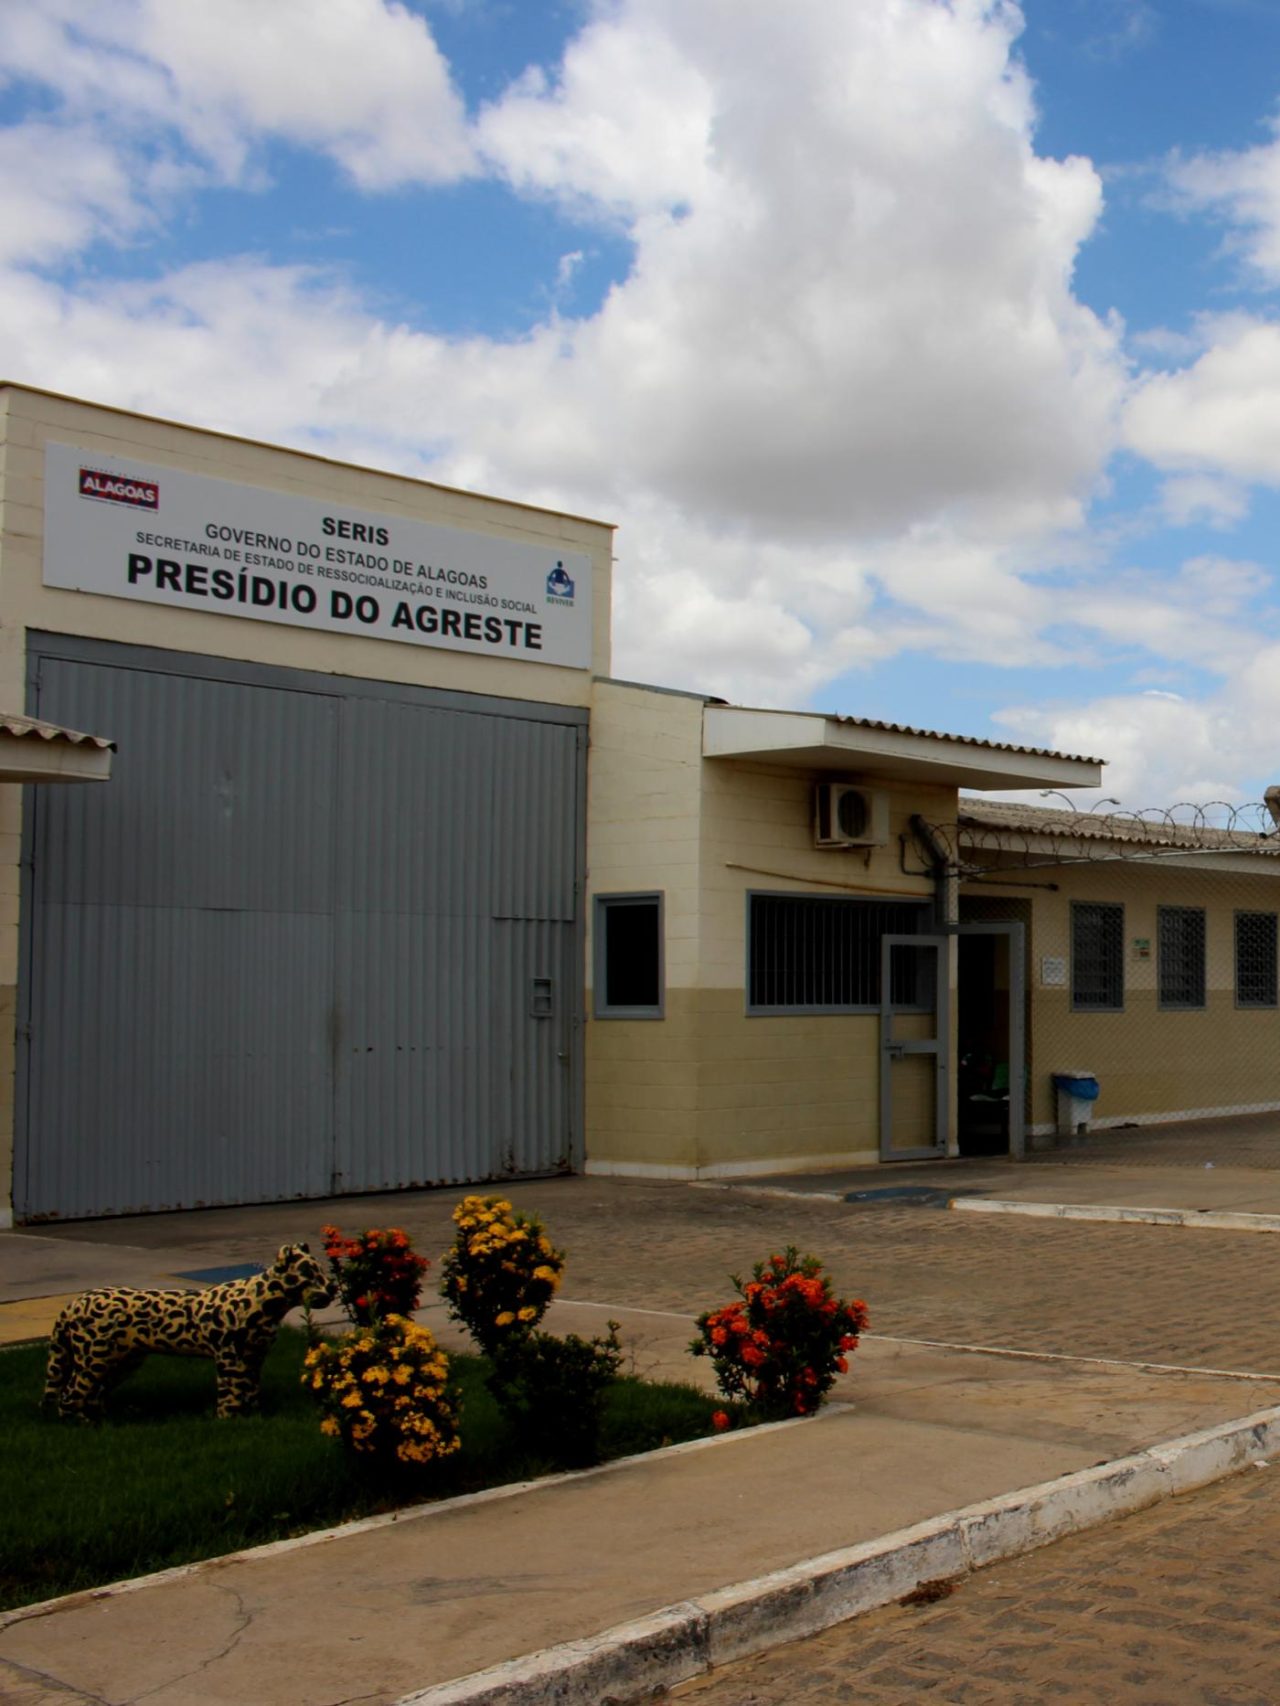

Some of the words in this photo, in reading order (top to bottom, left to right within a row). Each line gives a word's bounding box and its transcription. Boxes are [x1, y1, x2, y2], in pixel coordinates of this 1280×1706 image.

[83, 476, 156, 502] ALAGOAS
[205, 523, 292, 553] GOVERNO
[297, 541, 321, 559] DO
[325, 547, 389, 571] ESTADO
[393, 559, 414, 576] DE
[416, 564, 488, 589] ALAGOAS
[322, 517, 390, 546] SERIS
[128, 552, 317, 614] PRESÍDIO
[330, 589, 380, 624] DO
[391, 601, 543, 650] AGRESTE
[136, 531, 221, 558] SECRETARIA
[224, 548, 241, 562] DE
[245, 552, 295, 572] ESTADO
[298, 561, 314, 576] DE
[435, 587, 443, 598] E
[446, 589, 498, 607] INCLUSÃO
[501, 599, 537, 614] SOCIAL
